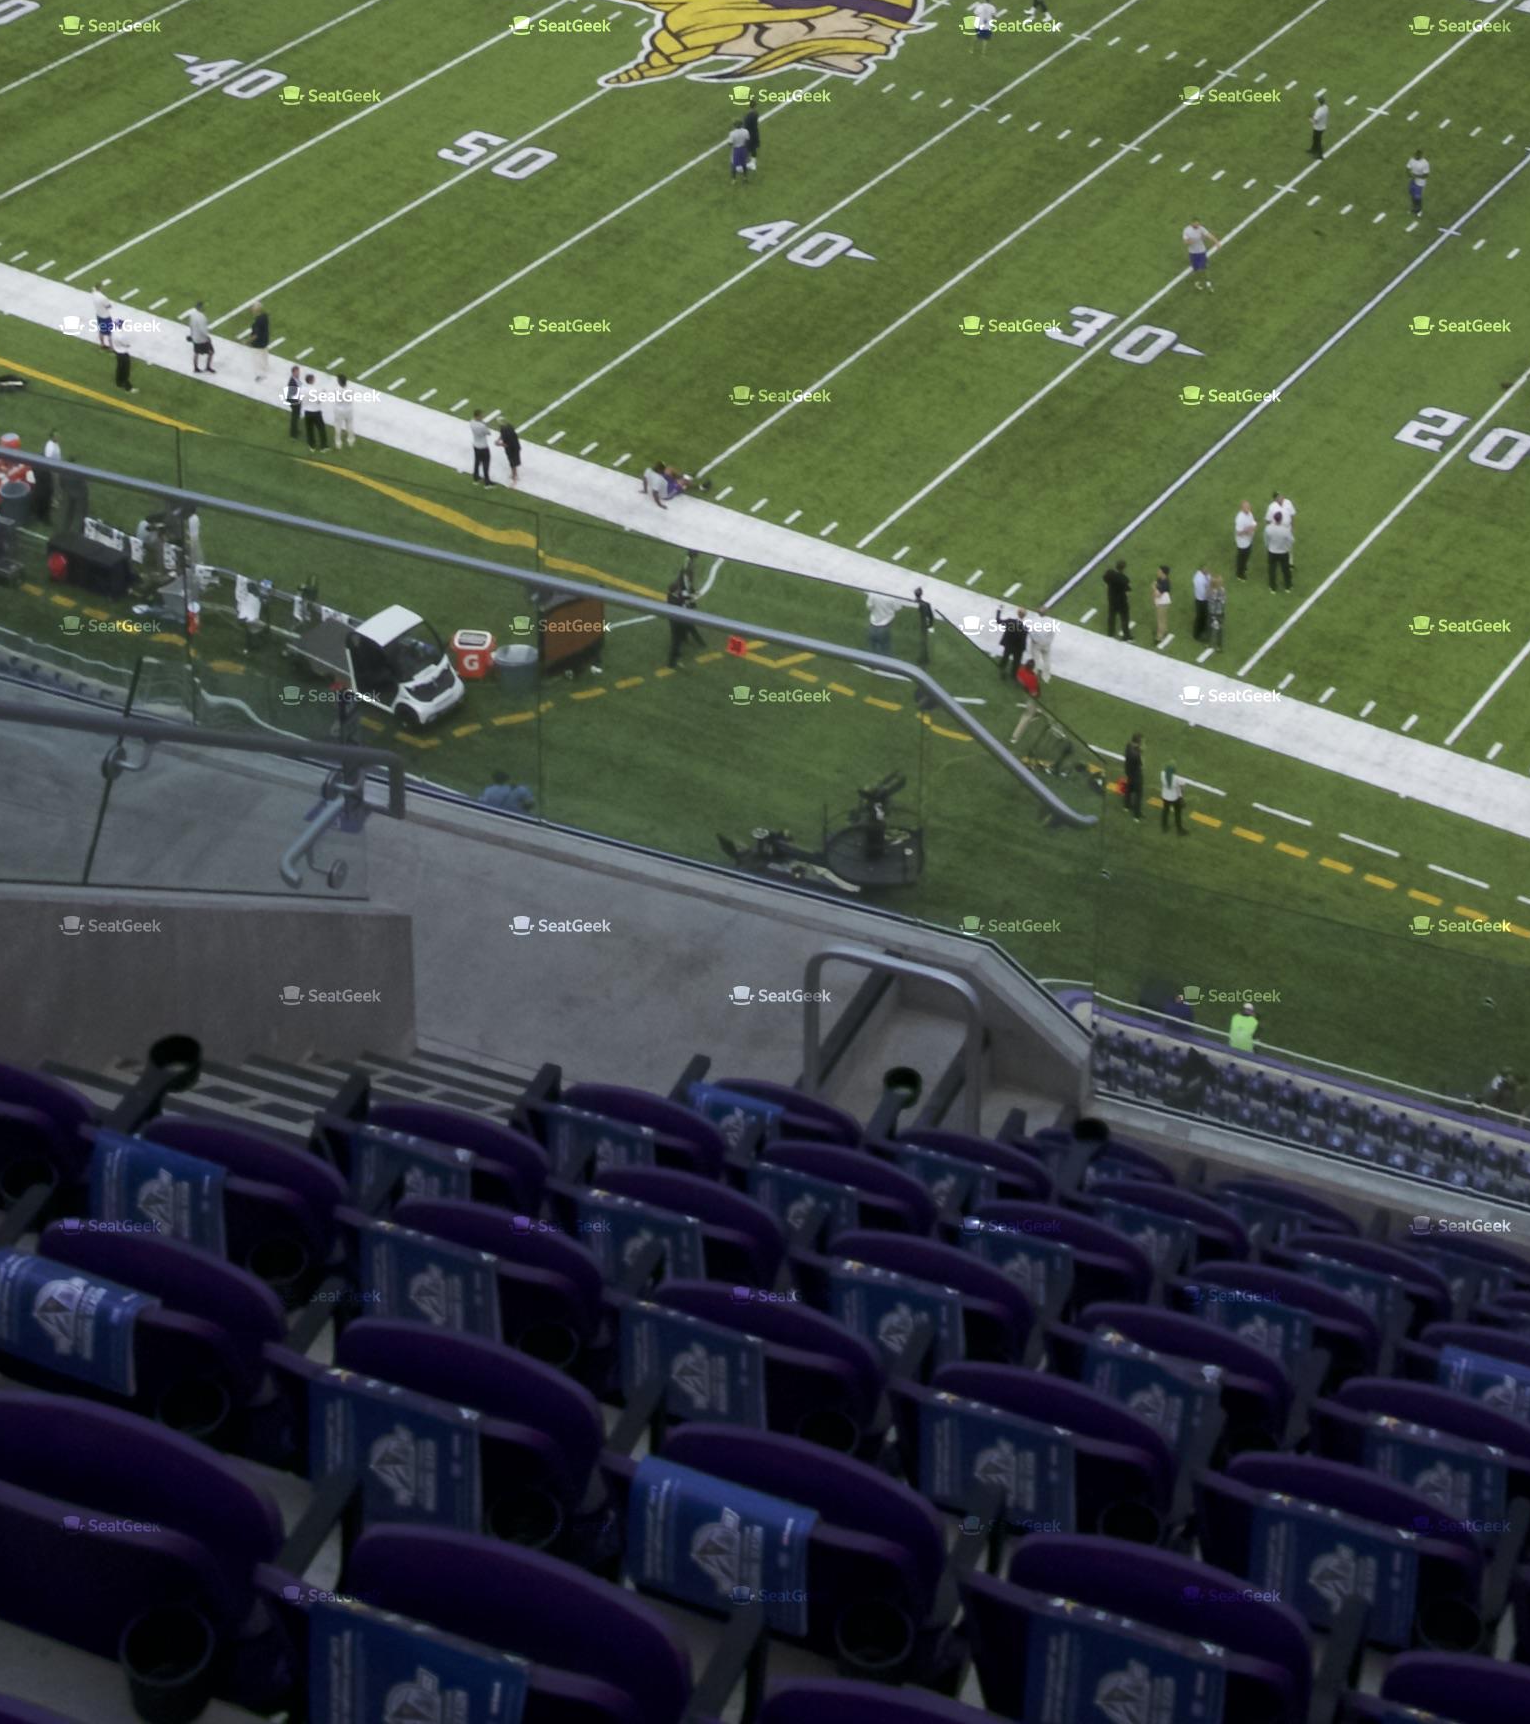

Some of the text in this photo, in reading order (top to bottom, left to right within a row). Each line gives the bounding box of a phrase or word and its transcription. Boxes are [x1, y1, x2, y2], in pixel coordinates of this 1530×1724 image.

[184, 58, 288, 99] 40
[437, 129, 558, 180] 50
[737, 219, 854, 268] 40
[1044, 304, 1178, 365] 30
[462, 654, 480, 671] G
